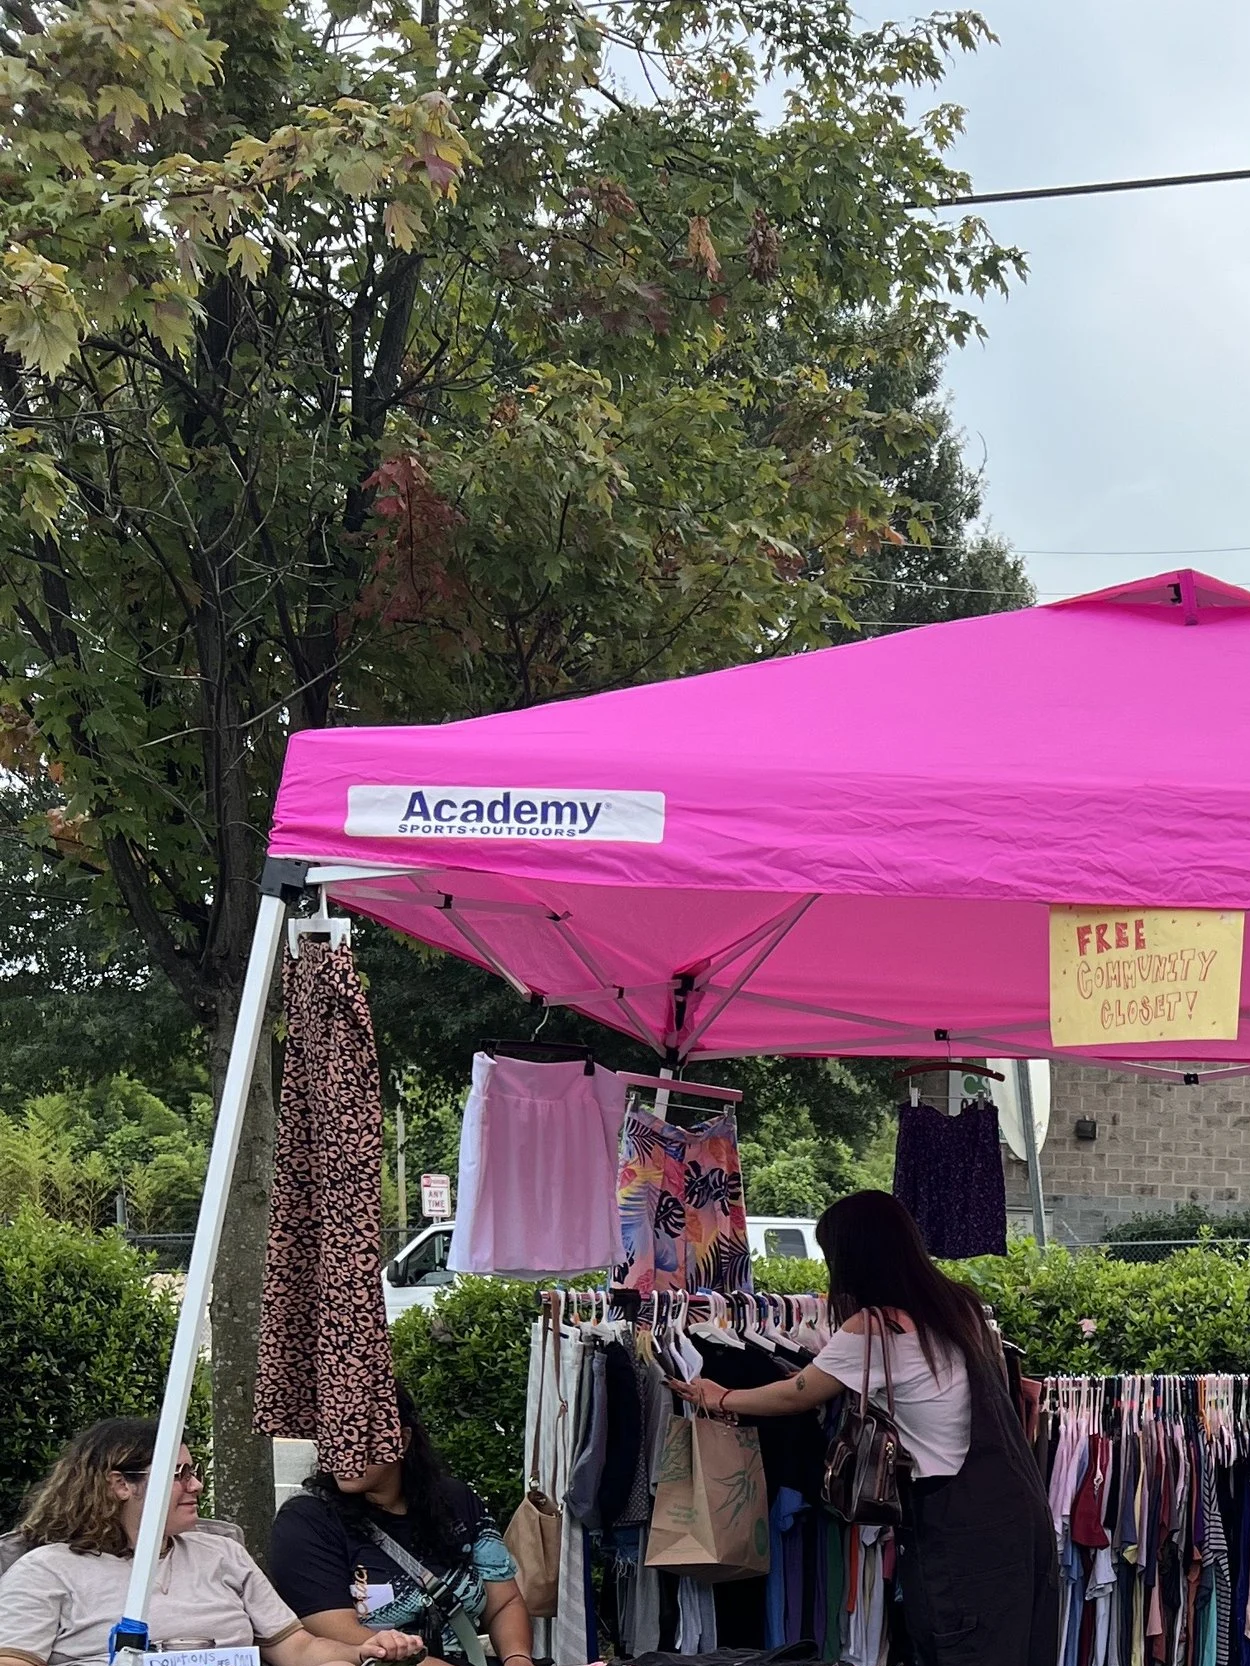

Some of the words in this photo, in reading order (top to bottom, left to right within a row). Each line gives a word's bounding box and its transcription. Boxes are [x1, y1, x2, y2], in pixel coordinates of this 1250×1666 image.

[398, 824, 576, 837] SPORTS+OUTDOORS
[401, 790, 602, 834] Academy
[1076, 919, 1147, 957] FREE
[1077, 948, 1218, 1000] COMMUNITY
[1100, 991, 1198, 1030] CLOSET!
[428, 1190, 444, 1199] ANY
[428, 1199, 446, 1208] TIME
